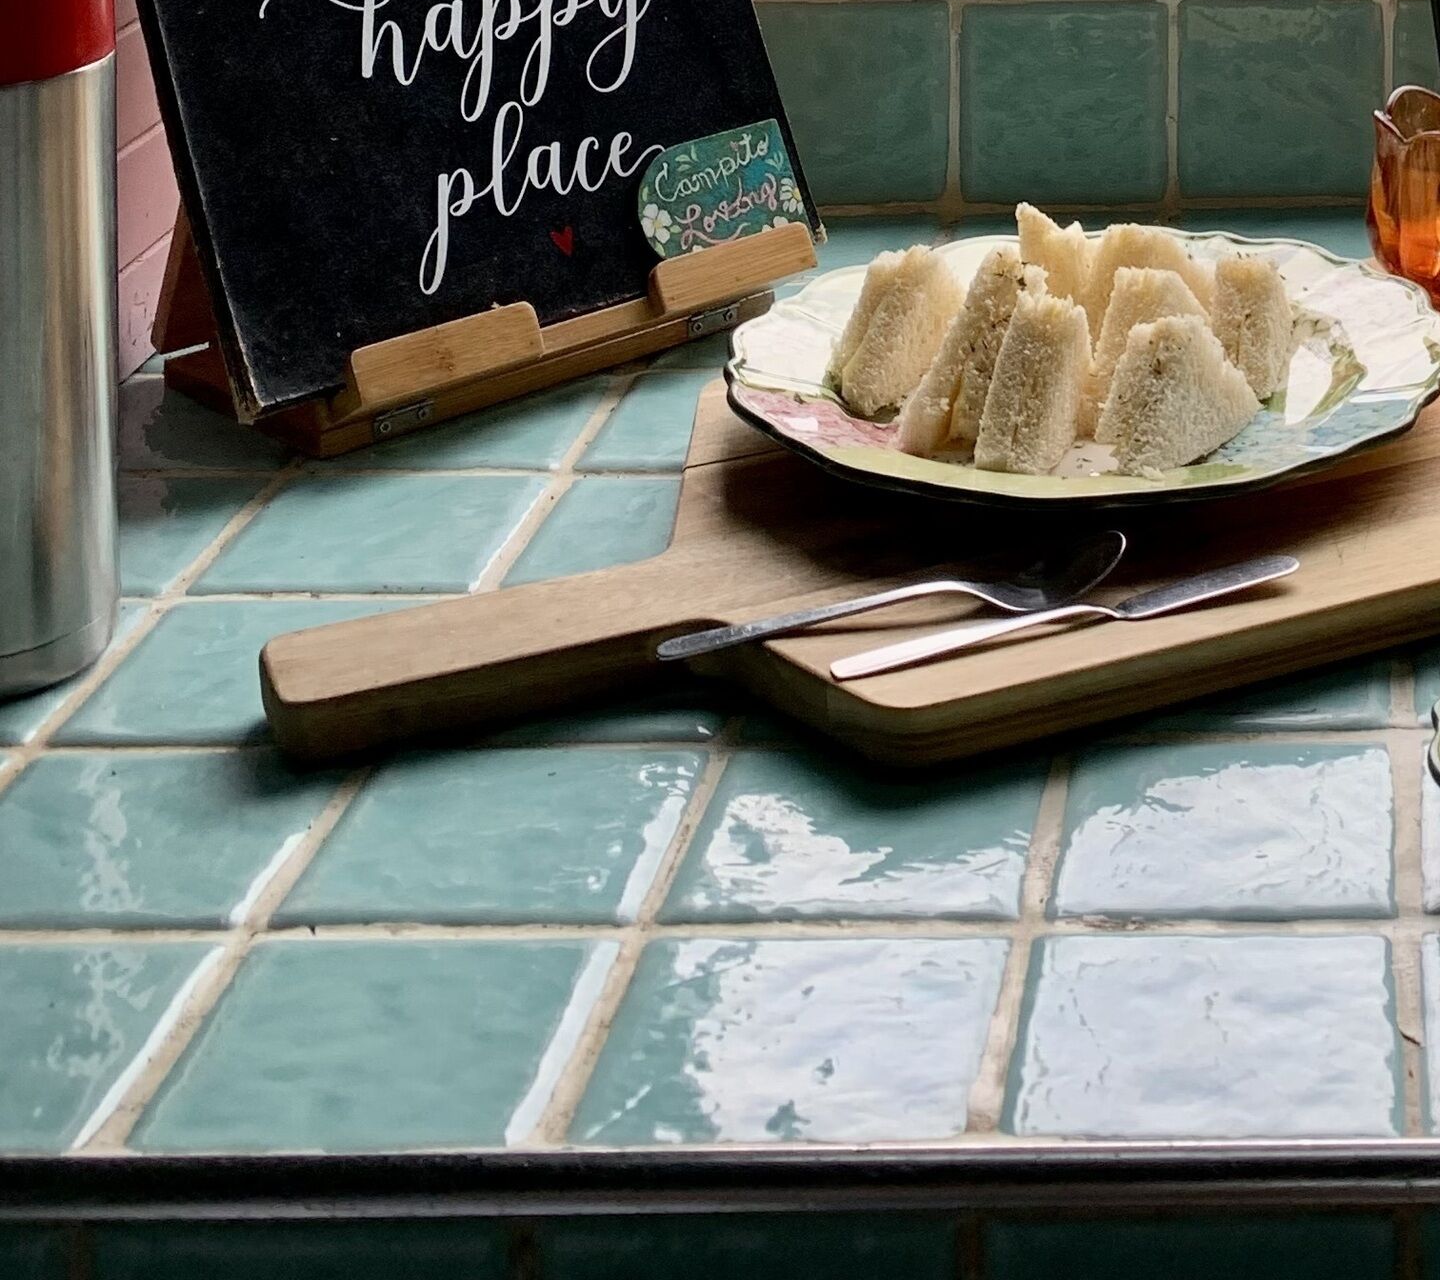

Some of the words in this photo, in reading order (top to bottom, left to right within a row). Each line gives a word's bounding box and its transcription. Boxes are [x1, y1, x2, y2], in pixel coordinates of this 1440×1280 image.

[418, 100, 669, 296] place
[653, 132, 770, 203] Campito
[673, 172, 779, 251] Loving
